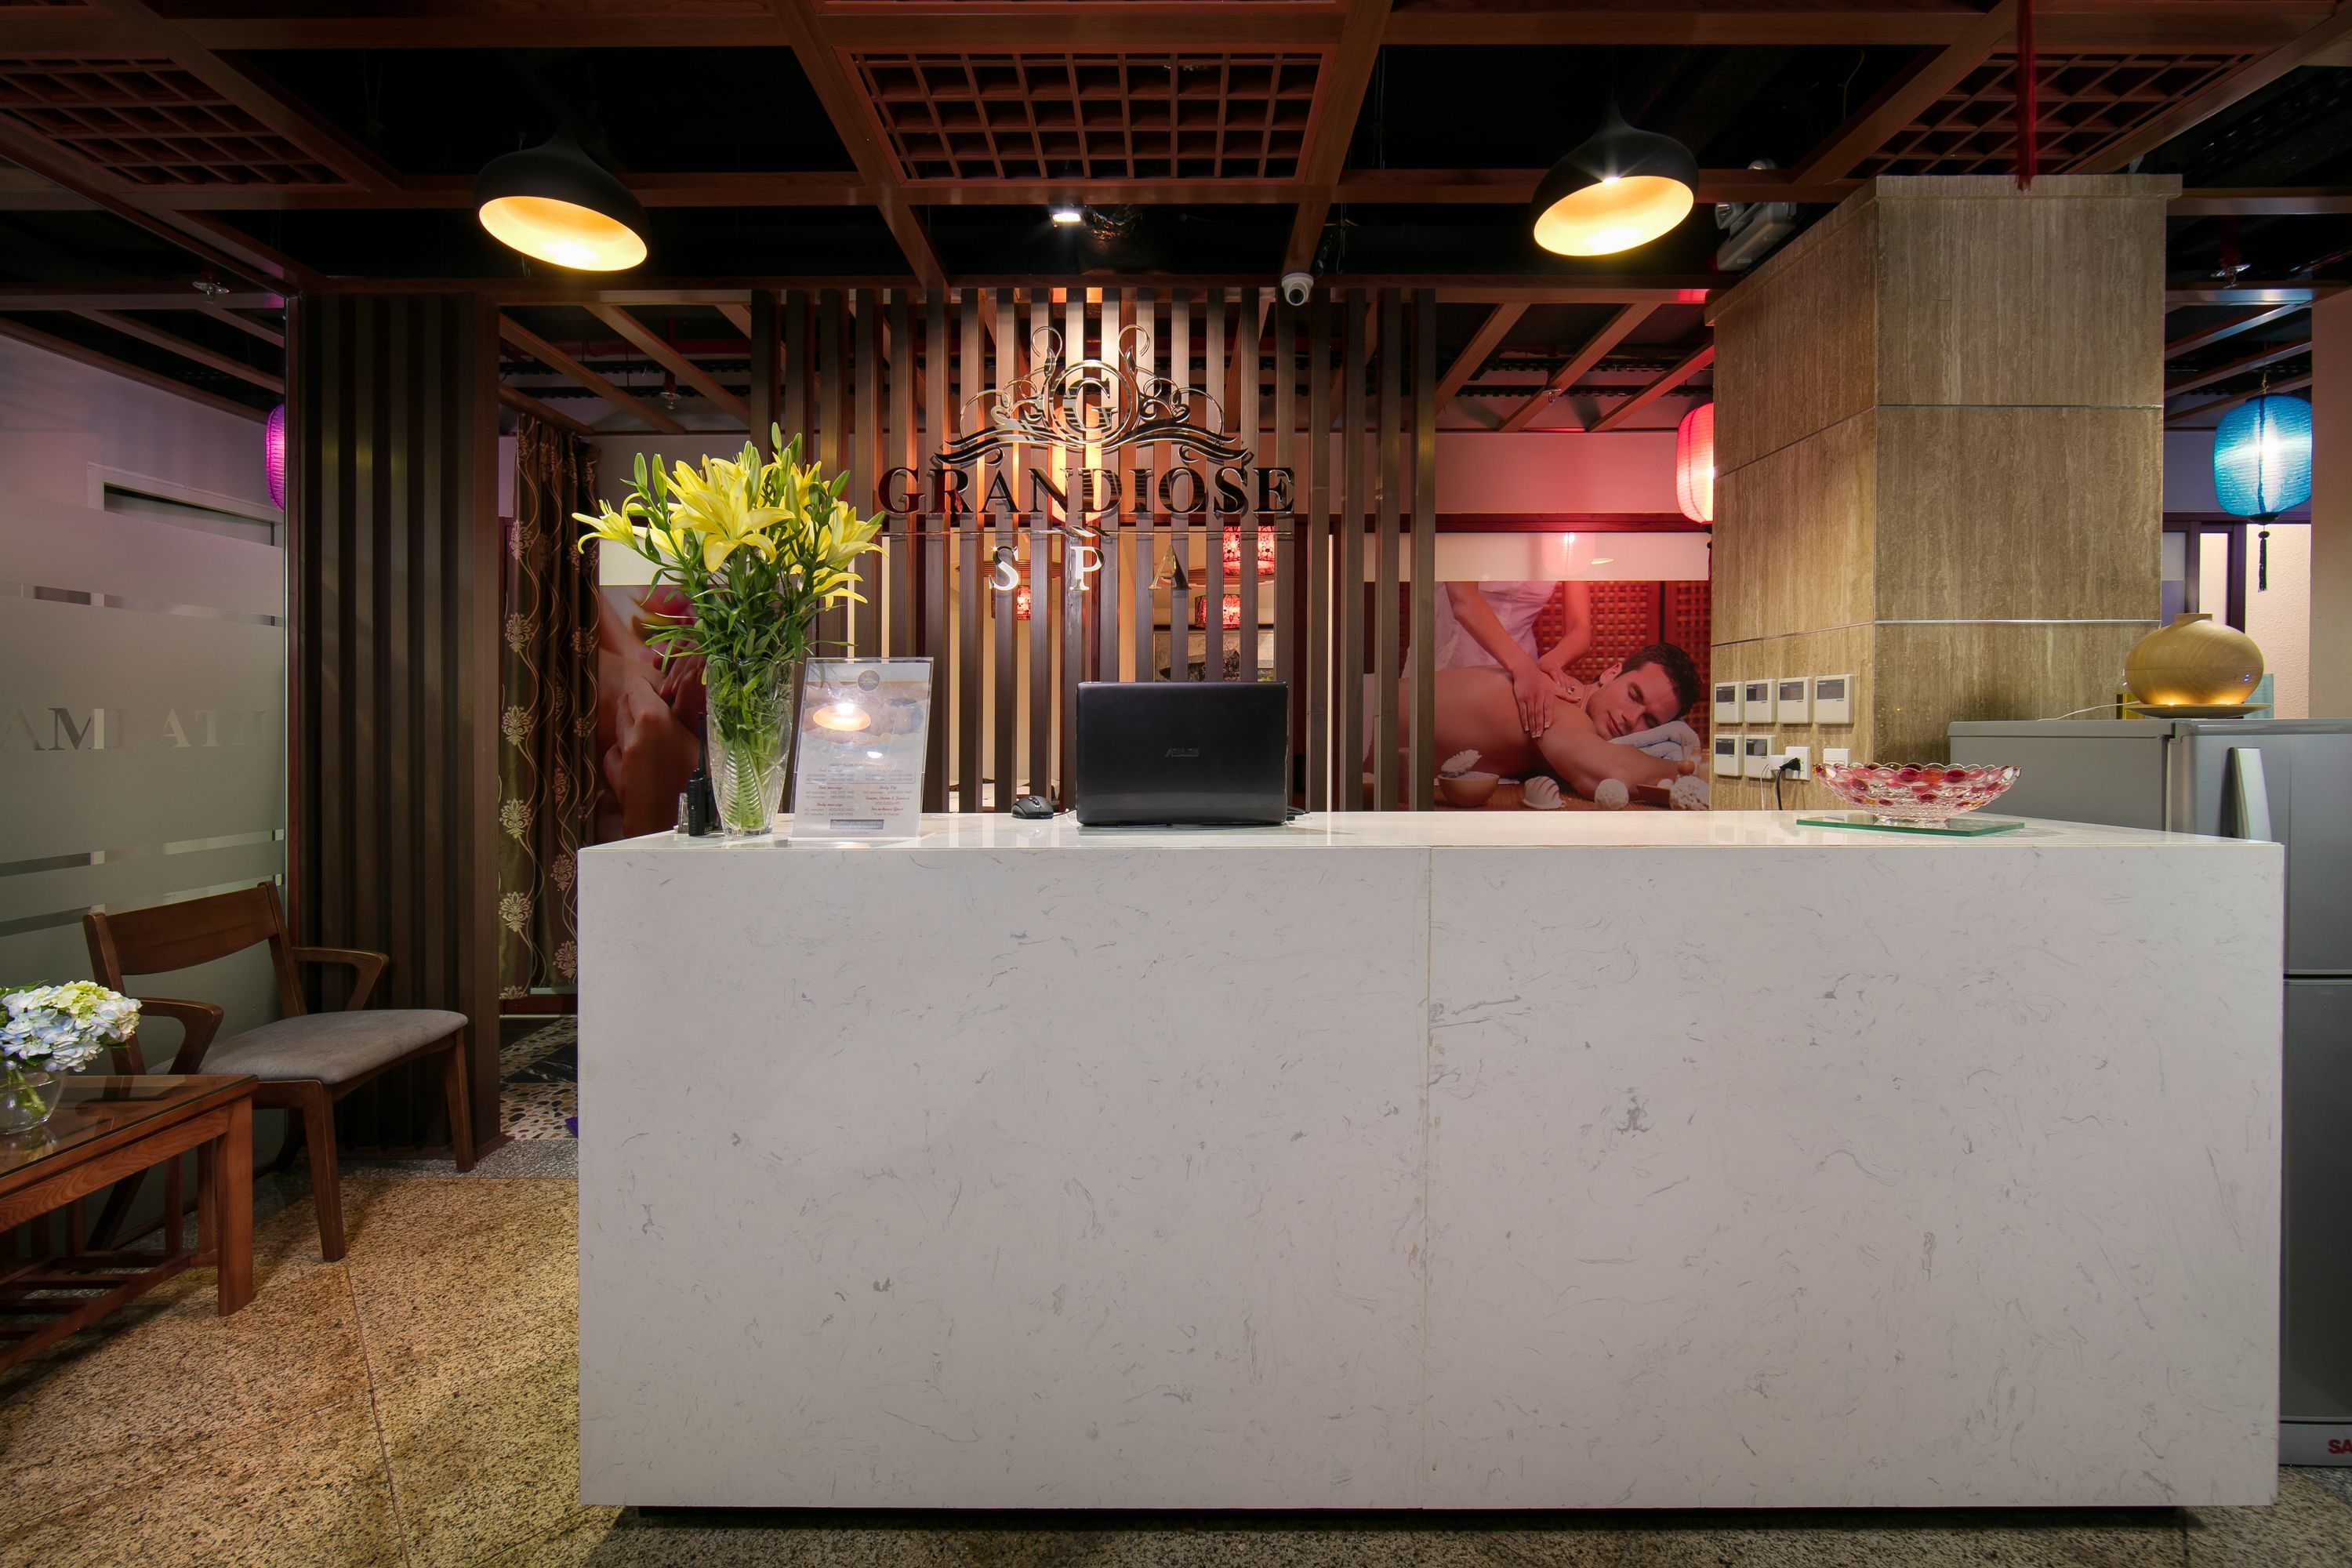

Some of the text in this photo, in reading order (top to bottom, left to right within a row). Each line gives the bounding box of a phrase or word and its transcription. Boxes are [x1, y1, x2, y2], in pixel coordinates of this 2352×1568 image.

[877, 466, 1296, 515] GRANDIOSE
[988, 544, 1192, 591] SPA
[1164, 748, 1200, 757] ASUS
